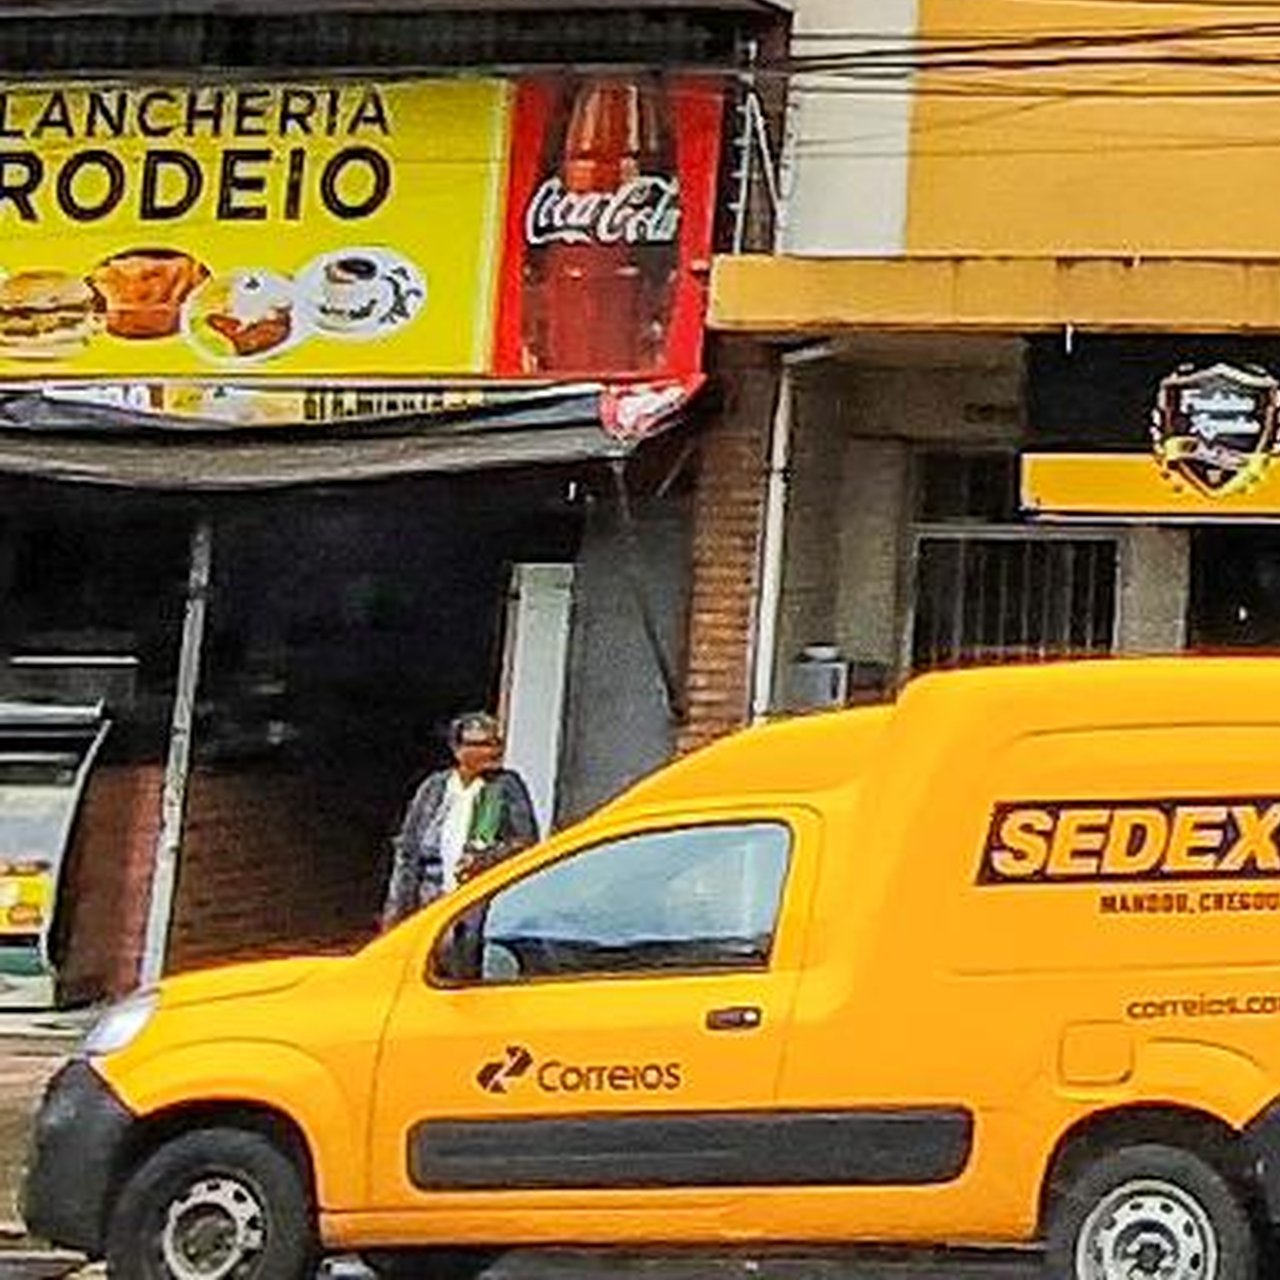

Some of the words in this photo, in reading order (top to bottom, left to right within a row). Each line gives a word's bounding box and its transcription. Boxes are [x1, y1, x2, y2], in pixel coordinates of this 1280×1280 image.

[0, 90, 390, 139] LANCHERIA
[0, 146, 392, 222] RODEIO
[537, 1059, 682, 1093] Correios
